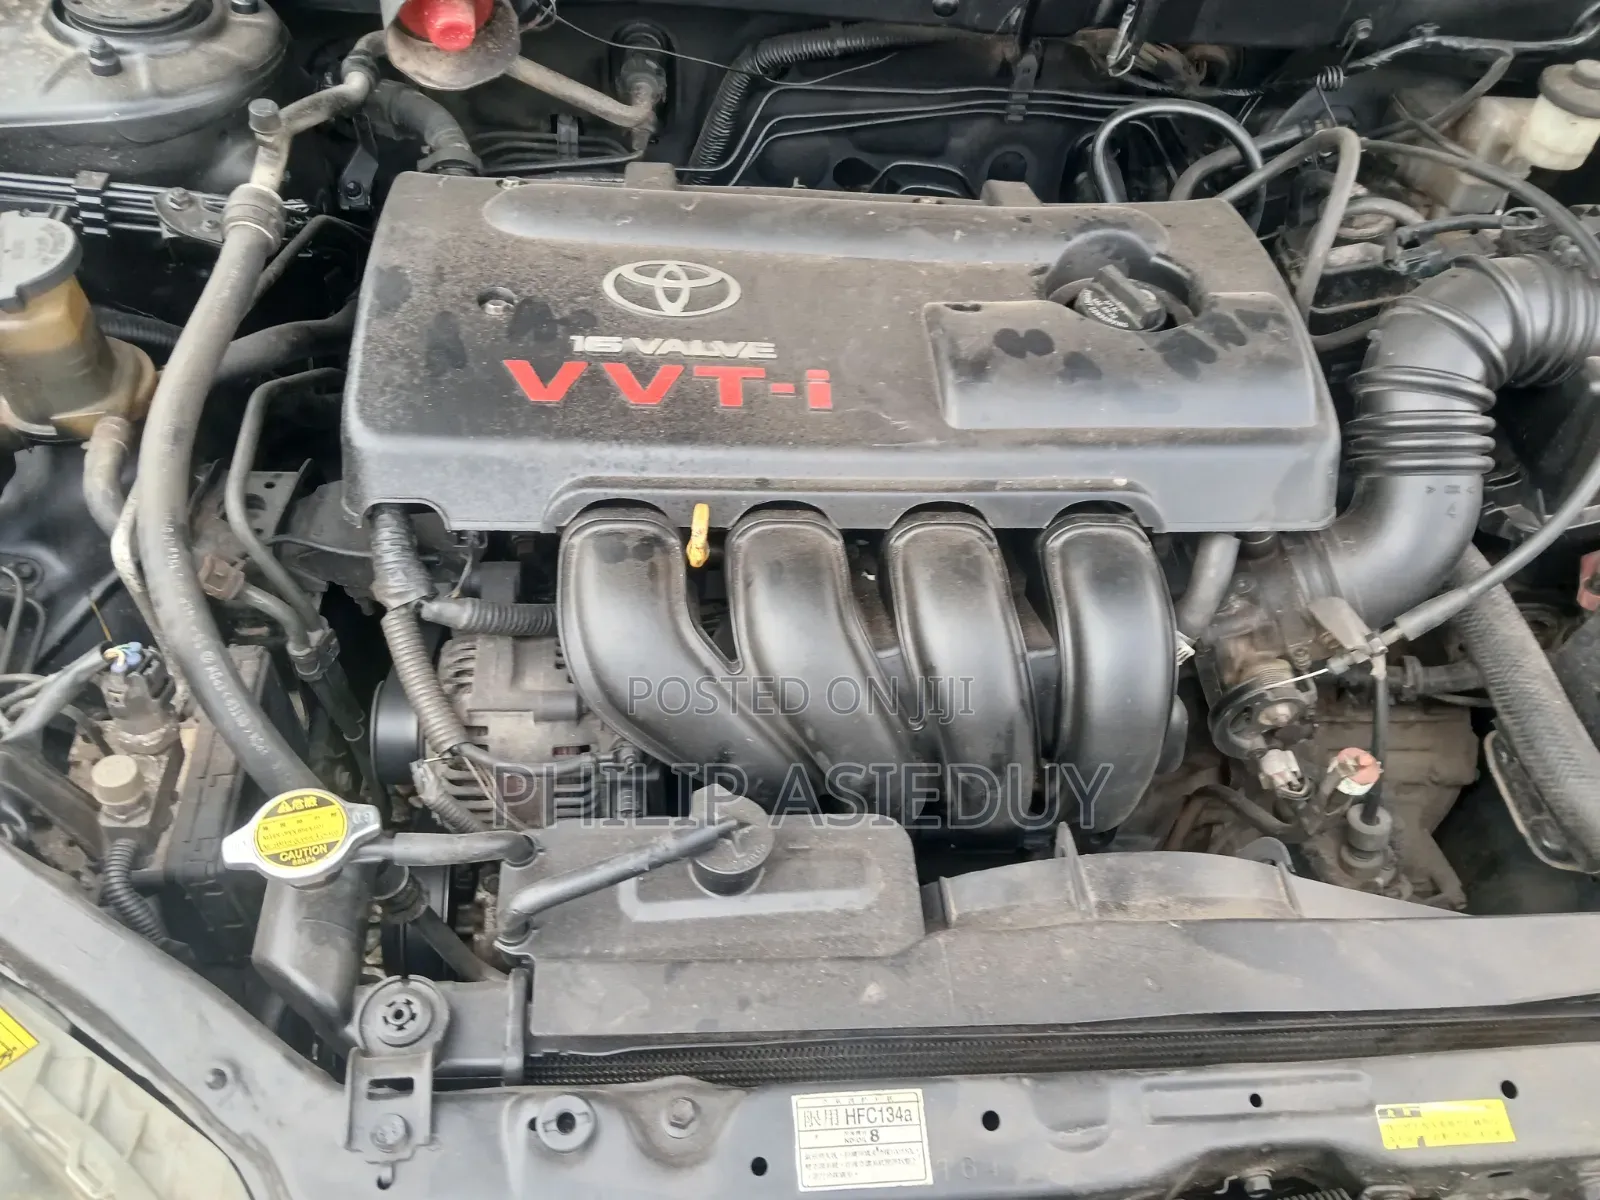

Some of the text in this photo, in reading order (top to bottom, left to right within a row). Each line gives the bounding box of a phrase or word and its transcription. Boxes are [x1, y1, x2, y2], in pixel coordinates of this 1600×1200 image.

[569, 335, 778, 359] 16 VALVE
[503, 359, 833, 409] VVT-i
[279, 844, 328, 862] CAUTION
[844, 1106, 913, 1126] HFC134a
[870, 1128, 880, 1142] 8
